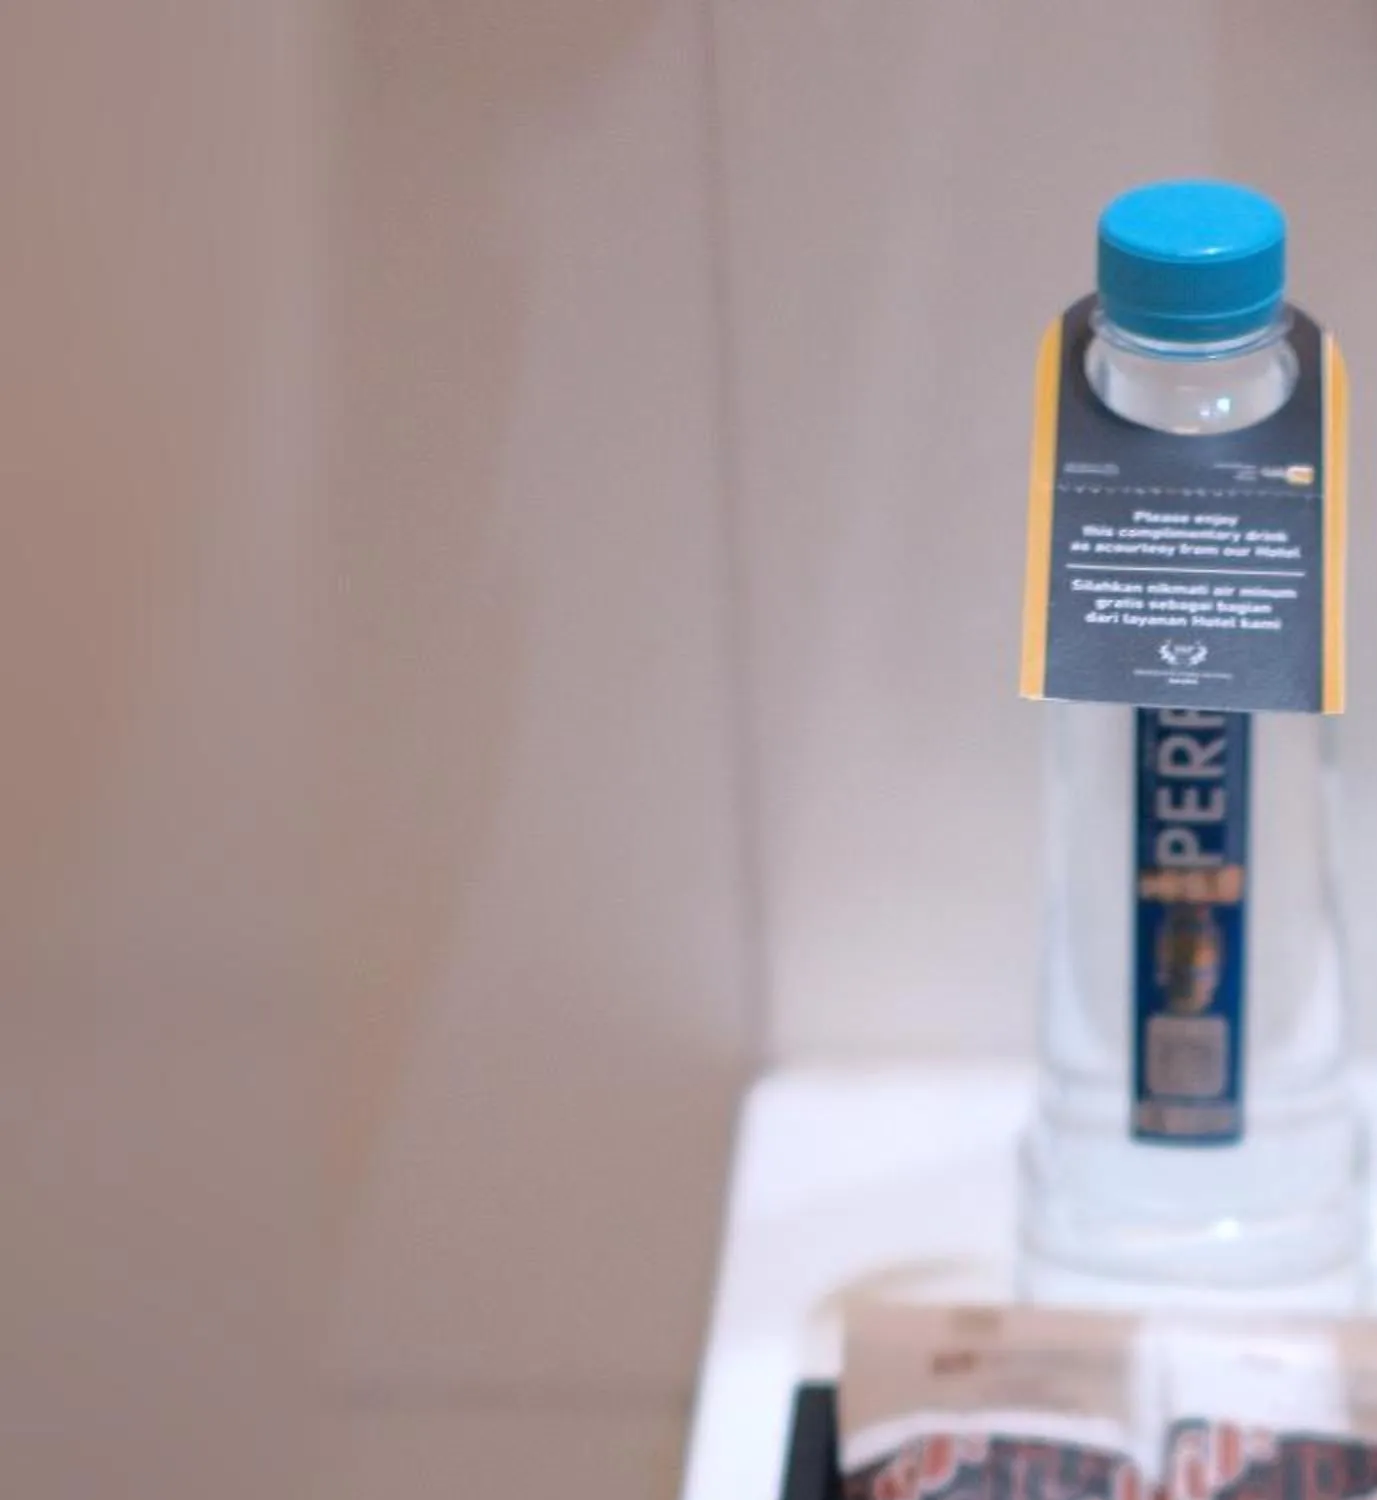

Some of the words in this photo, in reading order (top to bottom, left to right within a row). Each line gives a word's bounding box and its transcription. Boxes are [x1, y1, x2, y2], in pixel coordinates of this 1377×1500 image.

[1132, 510, 1190, 524] Please
[1194, 513, 1239, 527] enjoy
[1245, 530, 1288, 543] drink
[1178, 542, 1219, 555] from
[1223, 544, 1250, 557] our
[1254, 545, 1302, 559] Hotel
[1070, 578, 1143, 593] Silahkan
[1146, 582, 1209, 596] nikmati
[1213, 585, 1235, 597] air
[1239, 587, 1298, 599] minum
[1094, 598, 1144, 612] gratis
[1148, 599, 1214, 614] sebagai
[1216, 600, 1273, 616] bagian
[1084, 612, 1119, 624] dari
[1122, 612, 1188, 628] layanan
[1191, 615, 1236, 629] Hotel
[1240, 617, 1283, 631] kami
